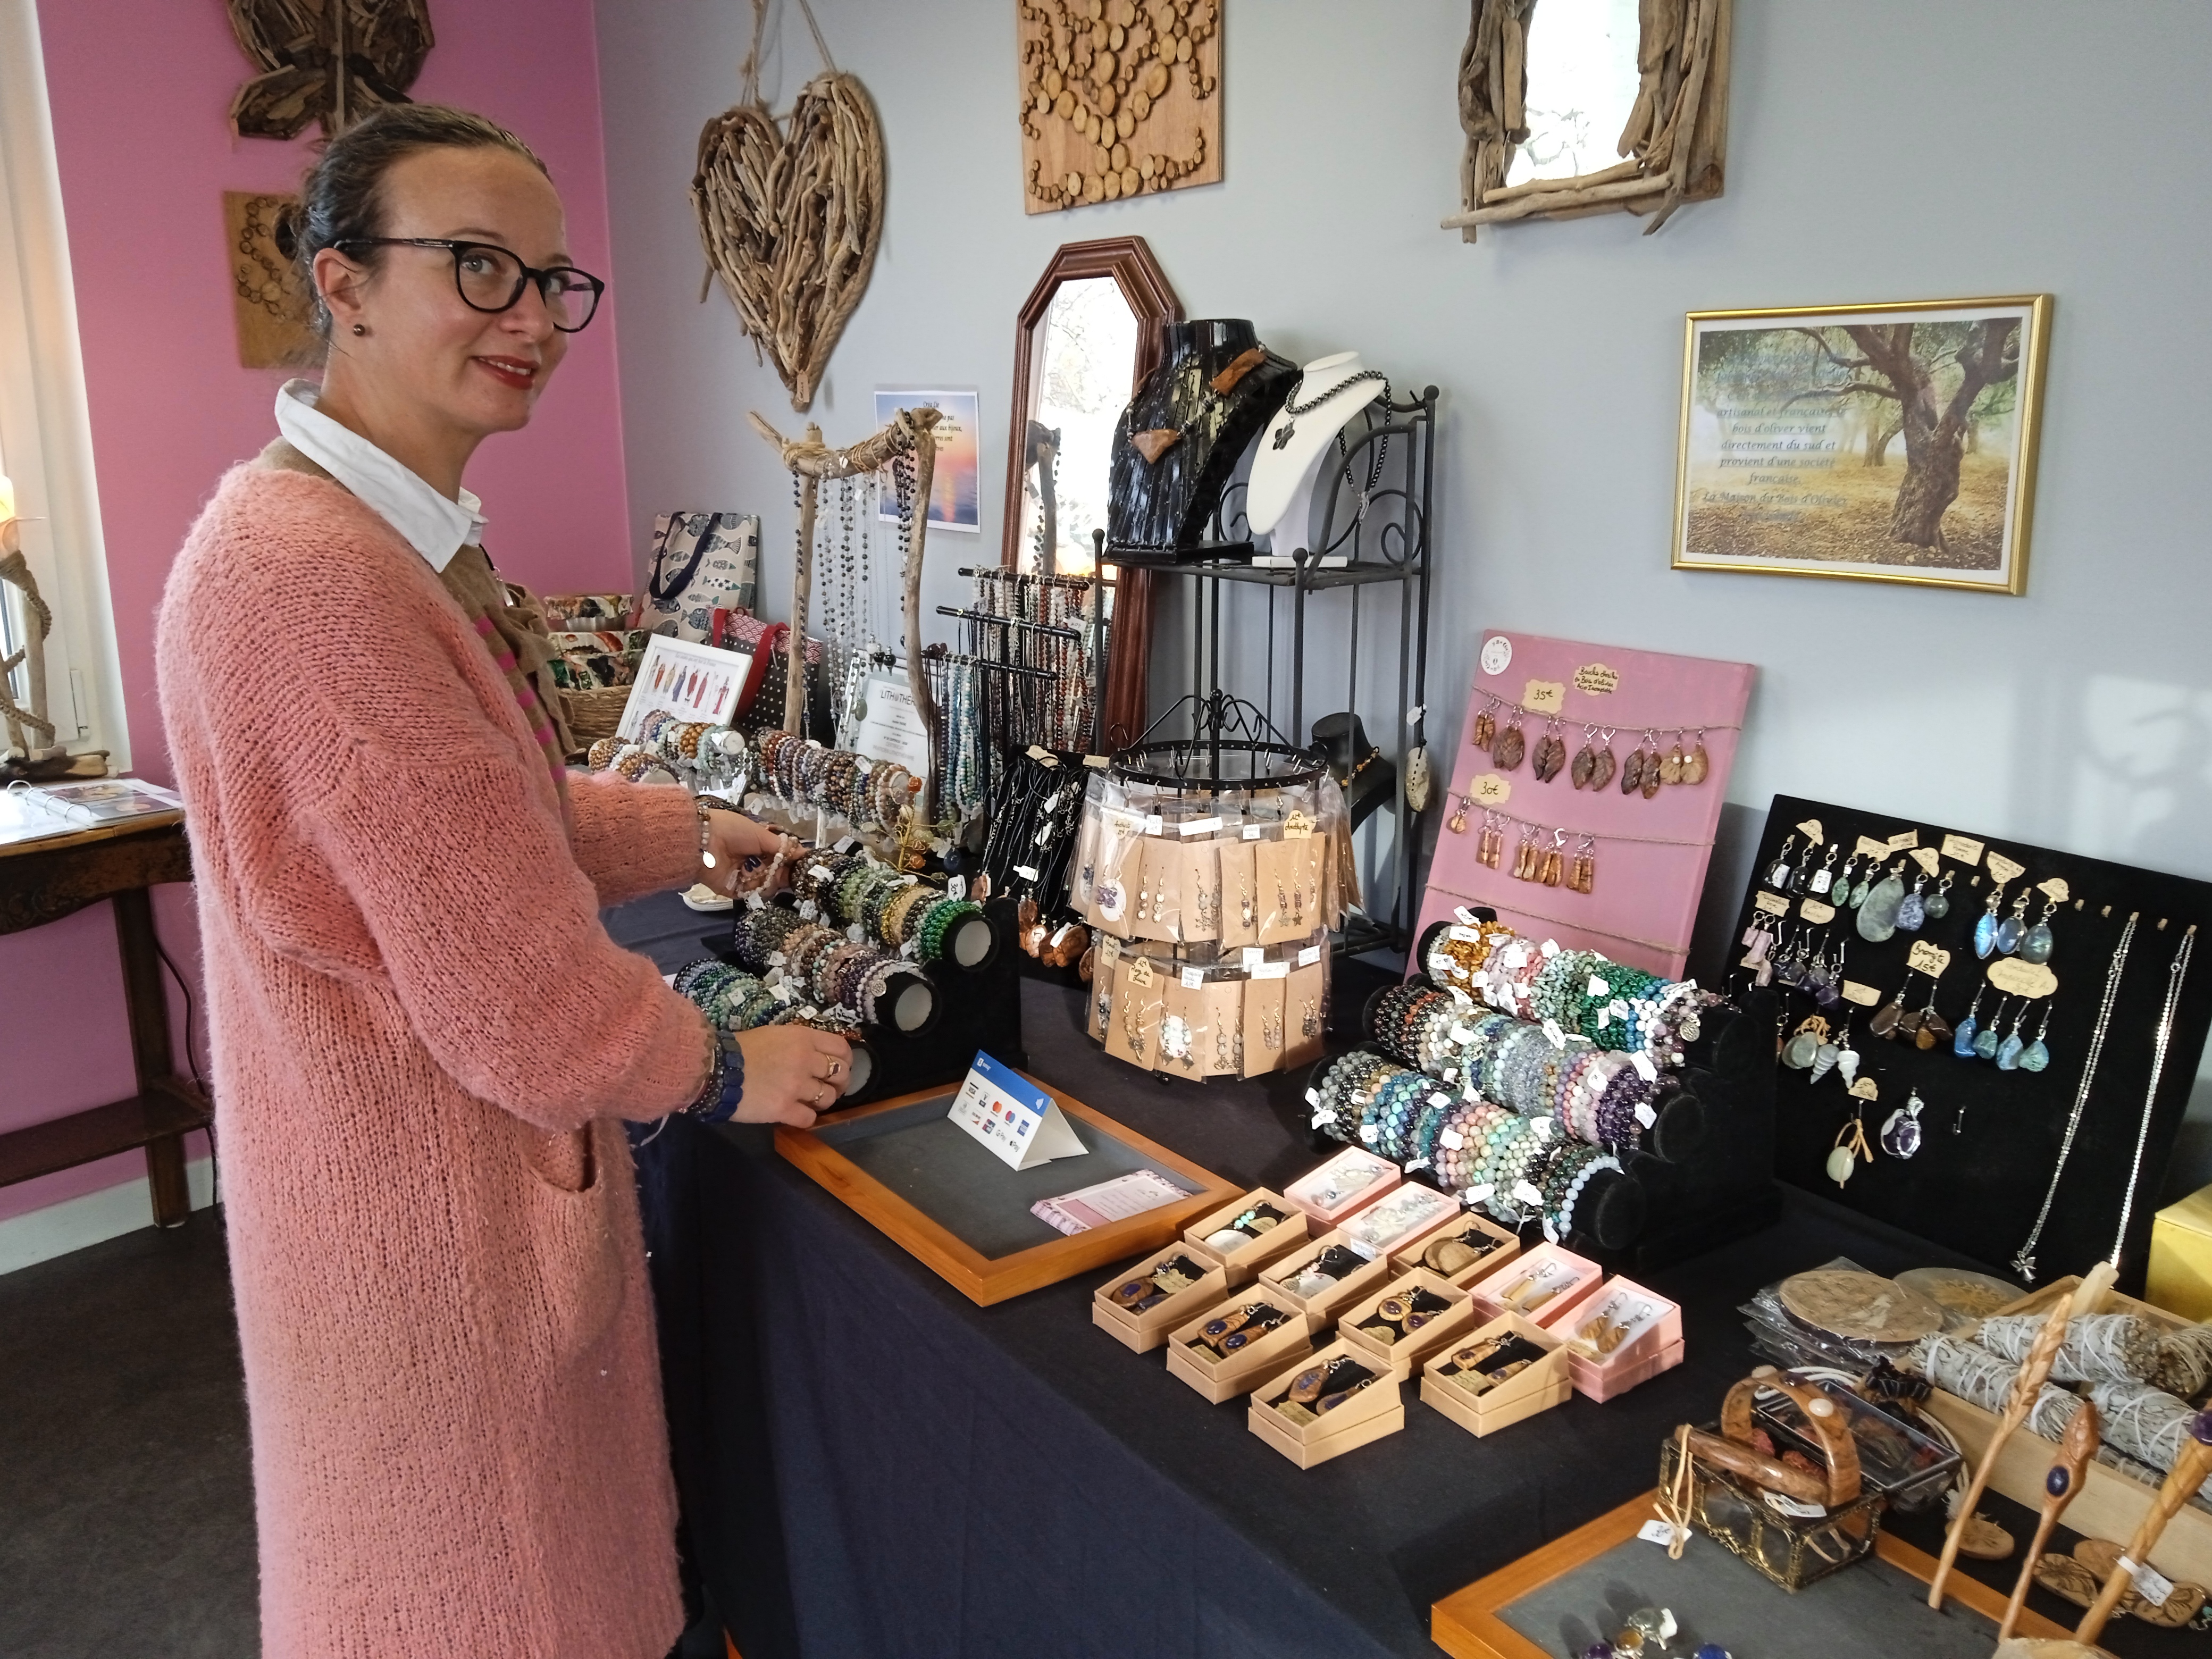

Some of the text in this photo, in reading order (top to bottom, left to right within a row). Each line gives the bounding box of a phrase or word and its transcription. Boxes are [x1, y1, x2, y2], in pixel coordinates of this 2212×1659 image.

[1717, 406, 1765, 417] artisanal
[1732, 422, 1751, 433] bois
[1798, 424, 1825, 433] vient
[1722, 440, 1836, 450] directement du sud et
[1719, 456, 1836, 469] provient d'une société
[1480, 781, 1499, 795] 30€
